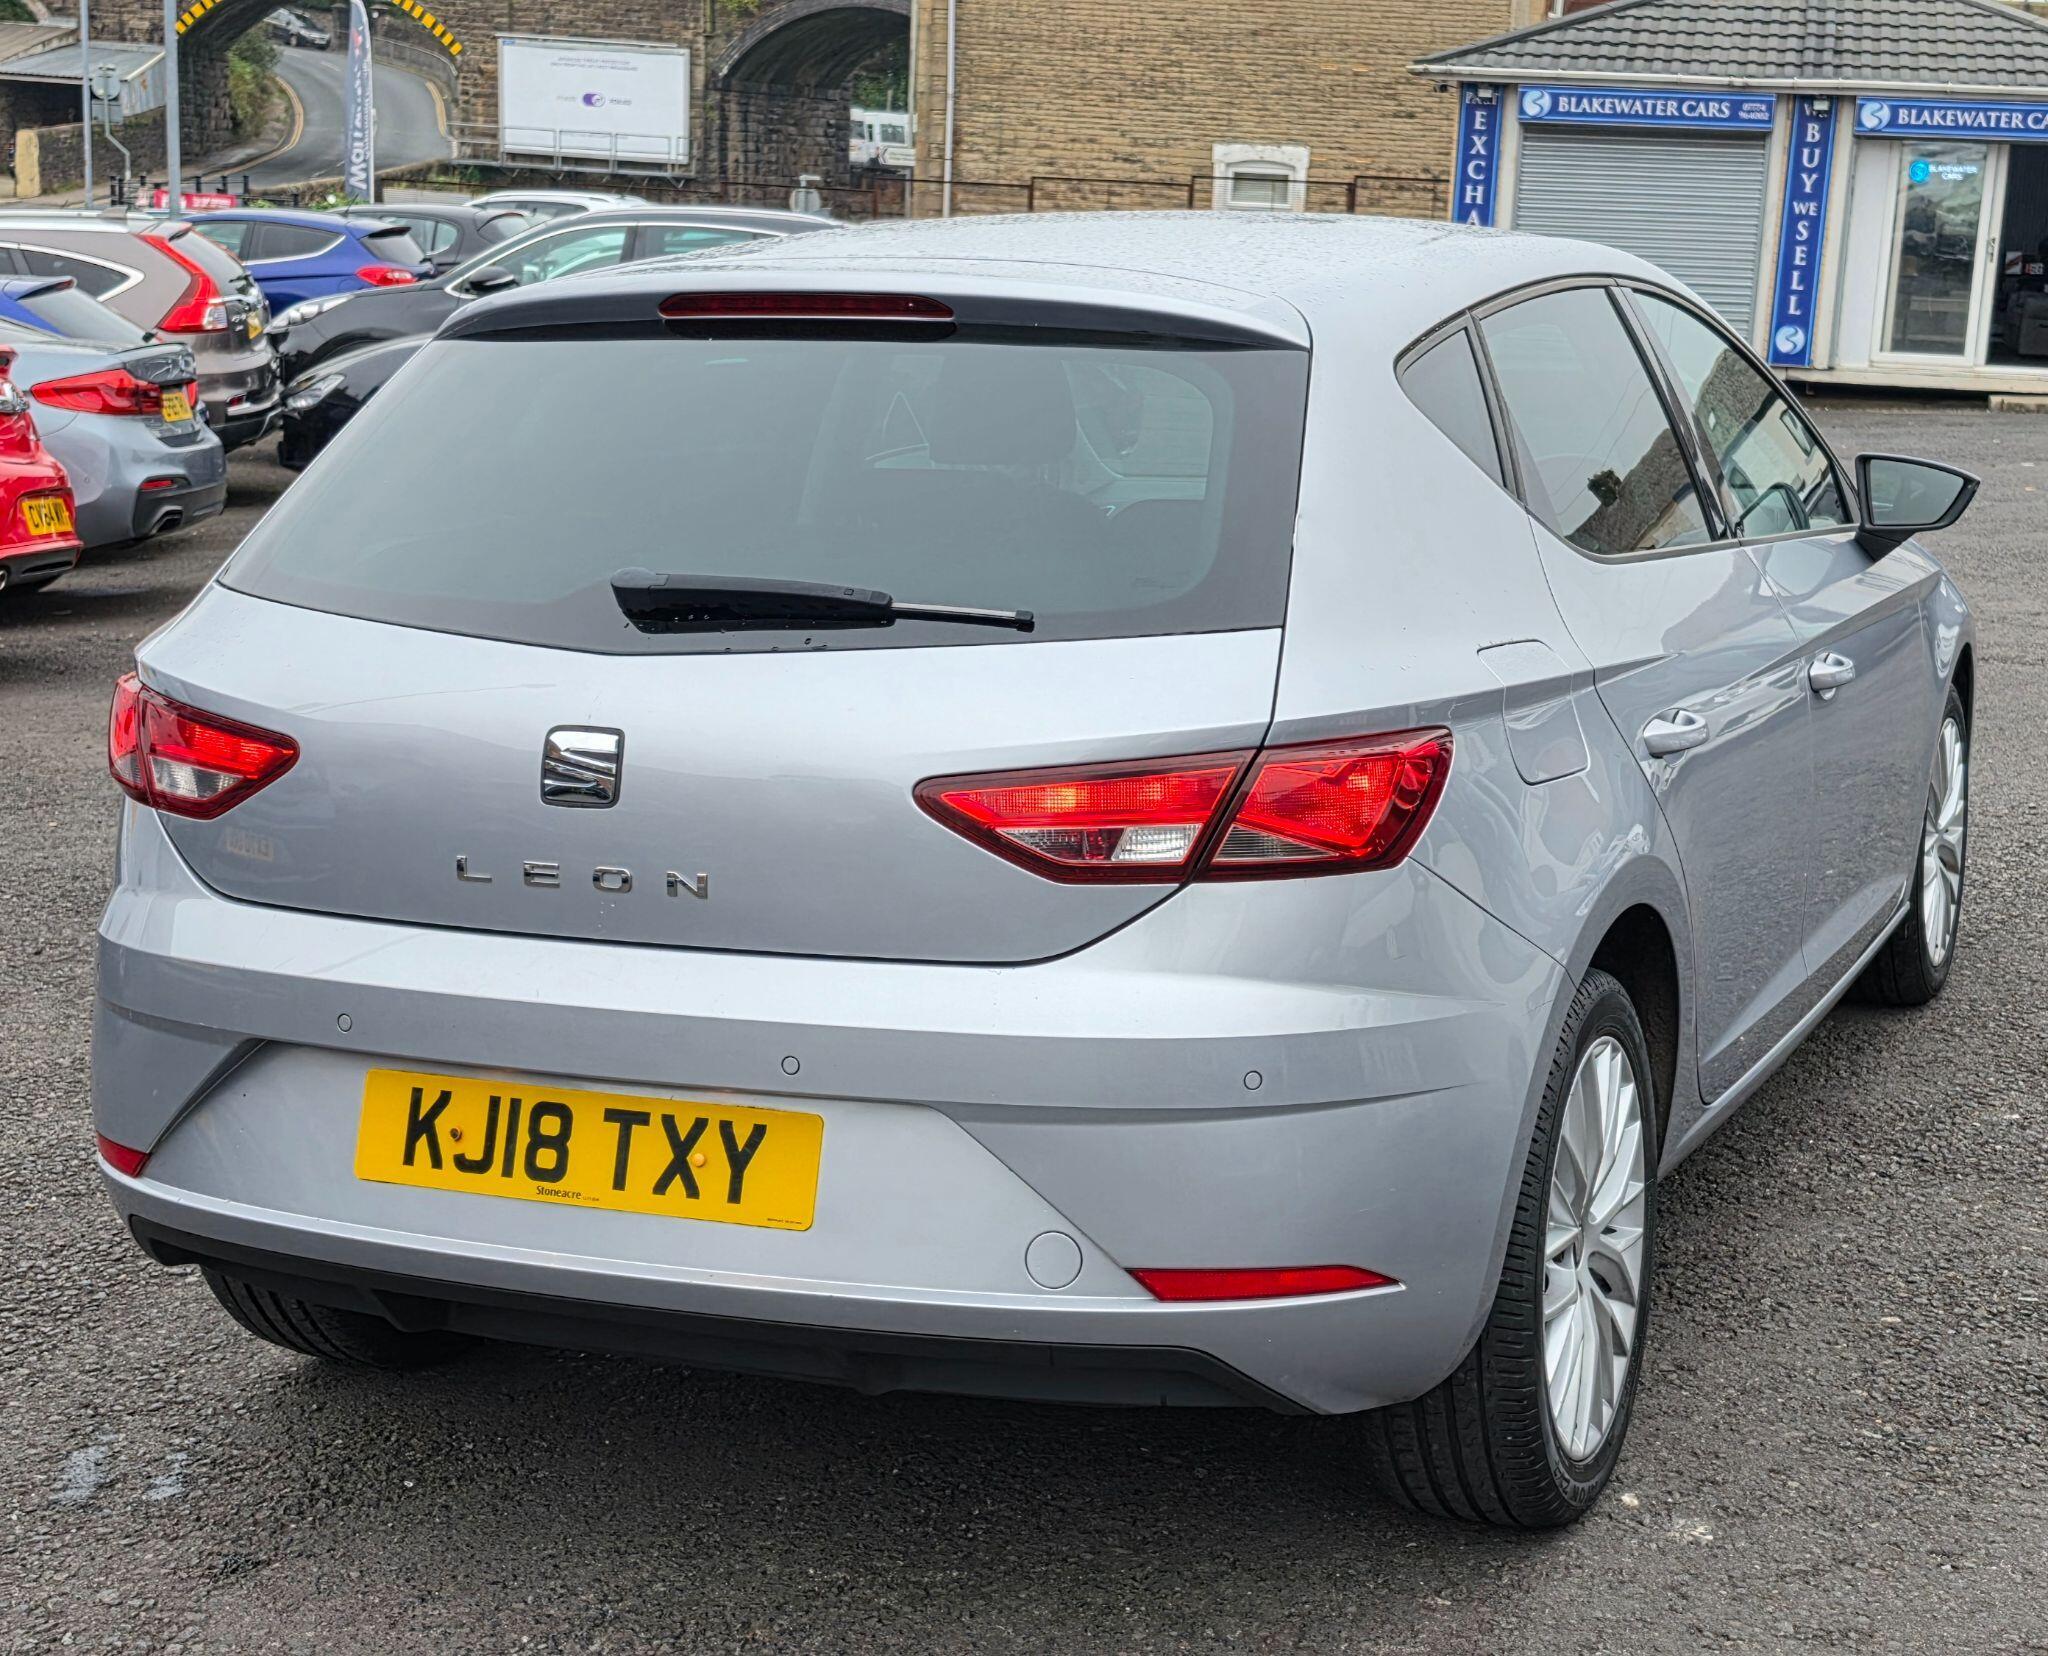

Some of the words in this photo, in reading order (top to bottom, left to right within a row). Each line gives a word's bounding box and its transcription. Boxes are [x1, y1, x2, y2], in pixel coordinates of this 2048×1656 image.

[1558, 96, 1679, 117] BLAKEWATER
[1681, 101, 1731, 119] CARS
[1898, 107, 2025, 129] BLAKEWATER
[1801, 122, 1822, 194] BUY
[1793, 201, 1819, 216] WE
[1788, 220, 1811, 316] SELL
[456, 855, 709, 900] LEON
[402, 1087, 574, 1184] KJ18
[603, 1108, 768, 1205] TXY
[535, 1185, 582, 1200] Stoneacre
